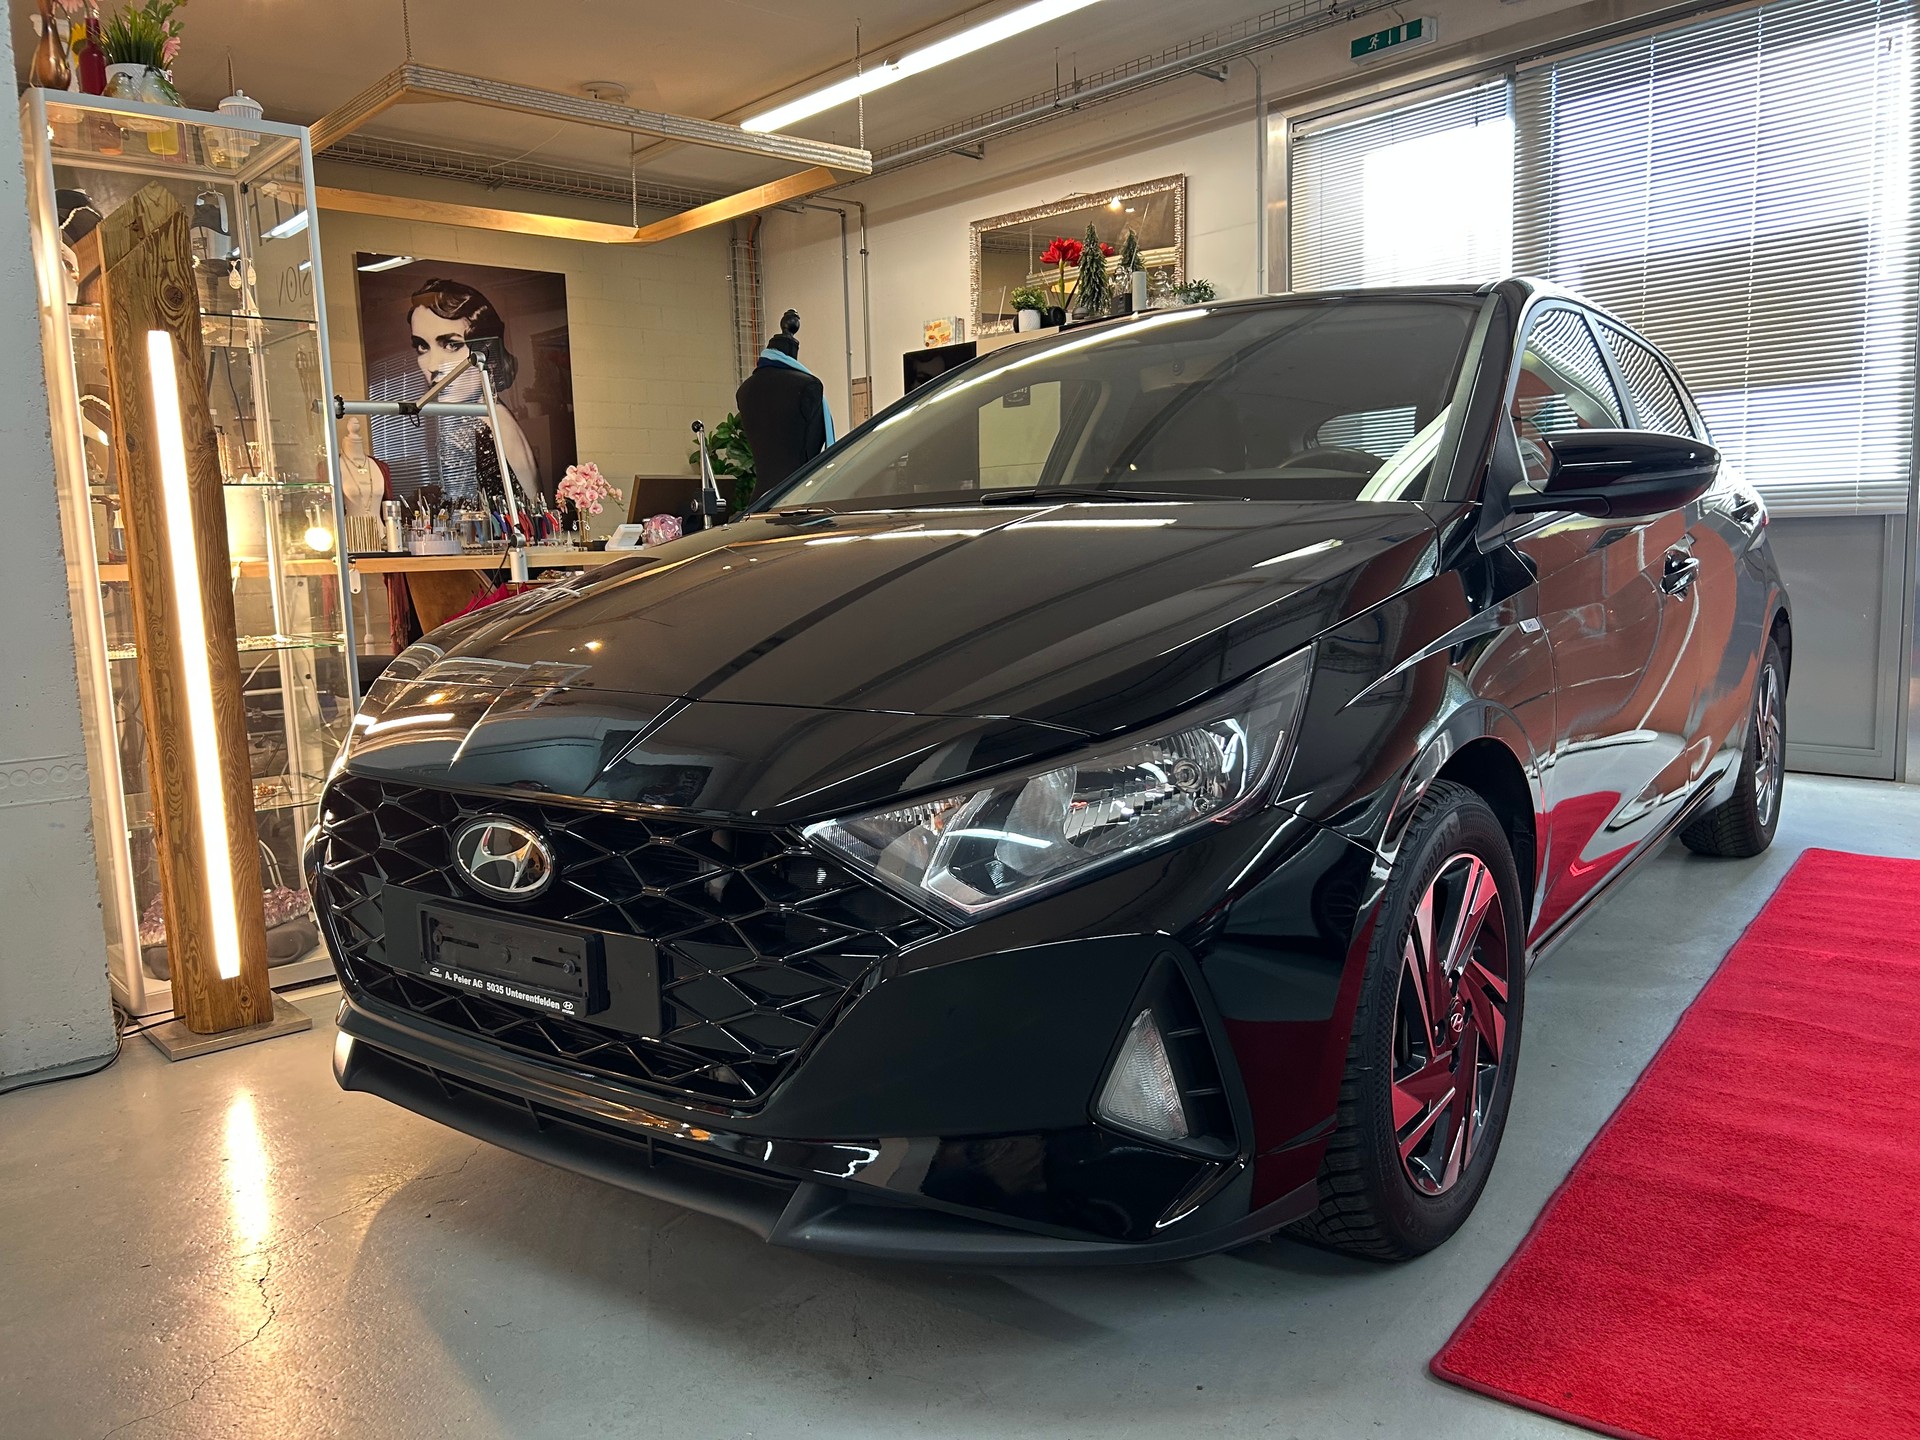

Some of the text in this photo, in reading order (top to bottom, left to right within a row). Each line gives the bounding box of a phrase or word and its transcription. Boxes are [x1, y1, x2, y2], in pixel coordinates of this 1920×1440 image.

[445, 971, 453, 980] A.
[453, 973, 471, 986] Peier
[472, 979, 483, 988] AG
[486, 982, 504, 995] 5035
[505, 987, 560, 1010] Unterentfelden
